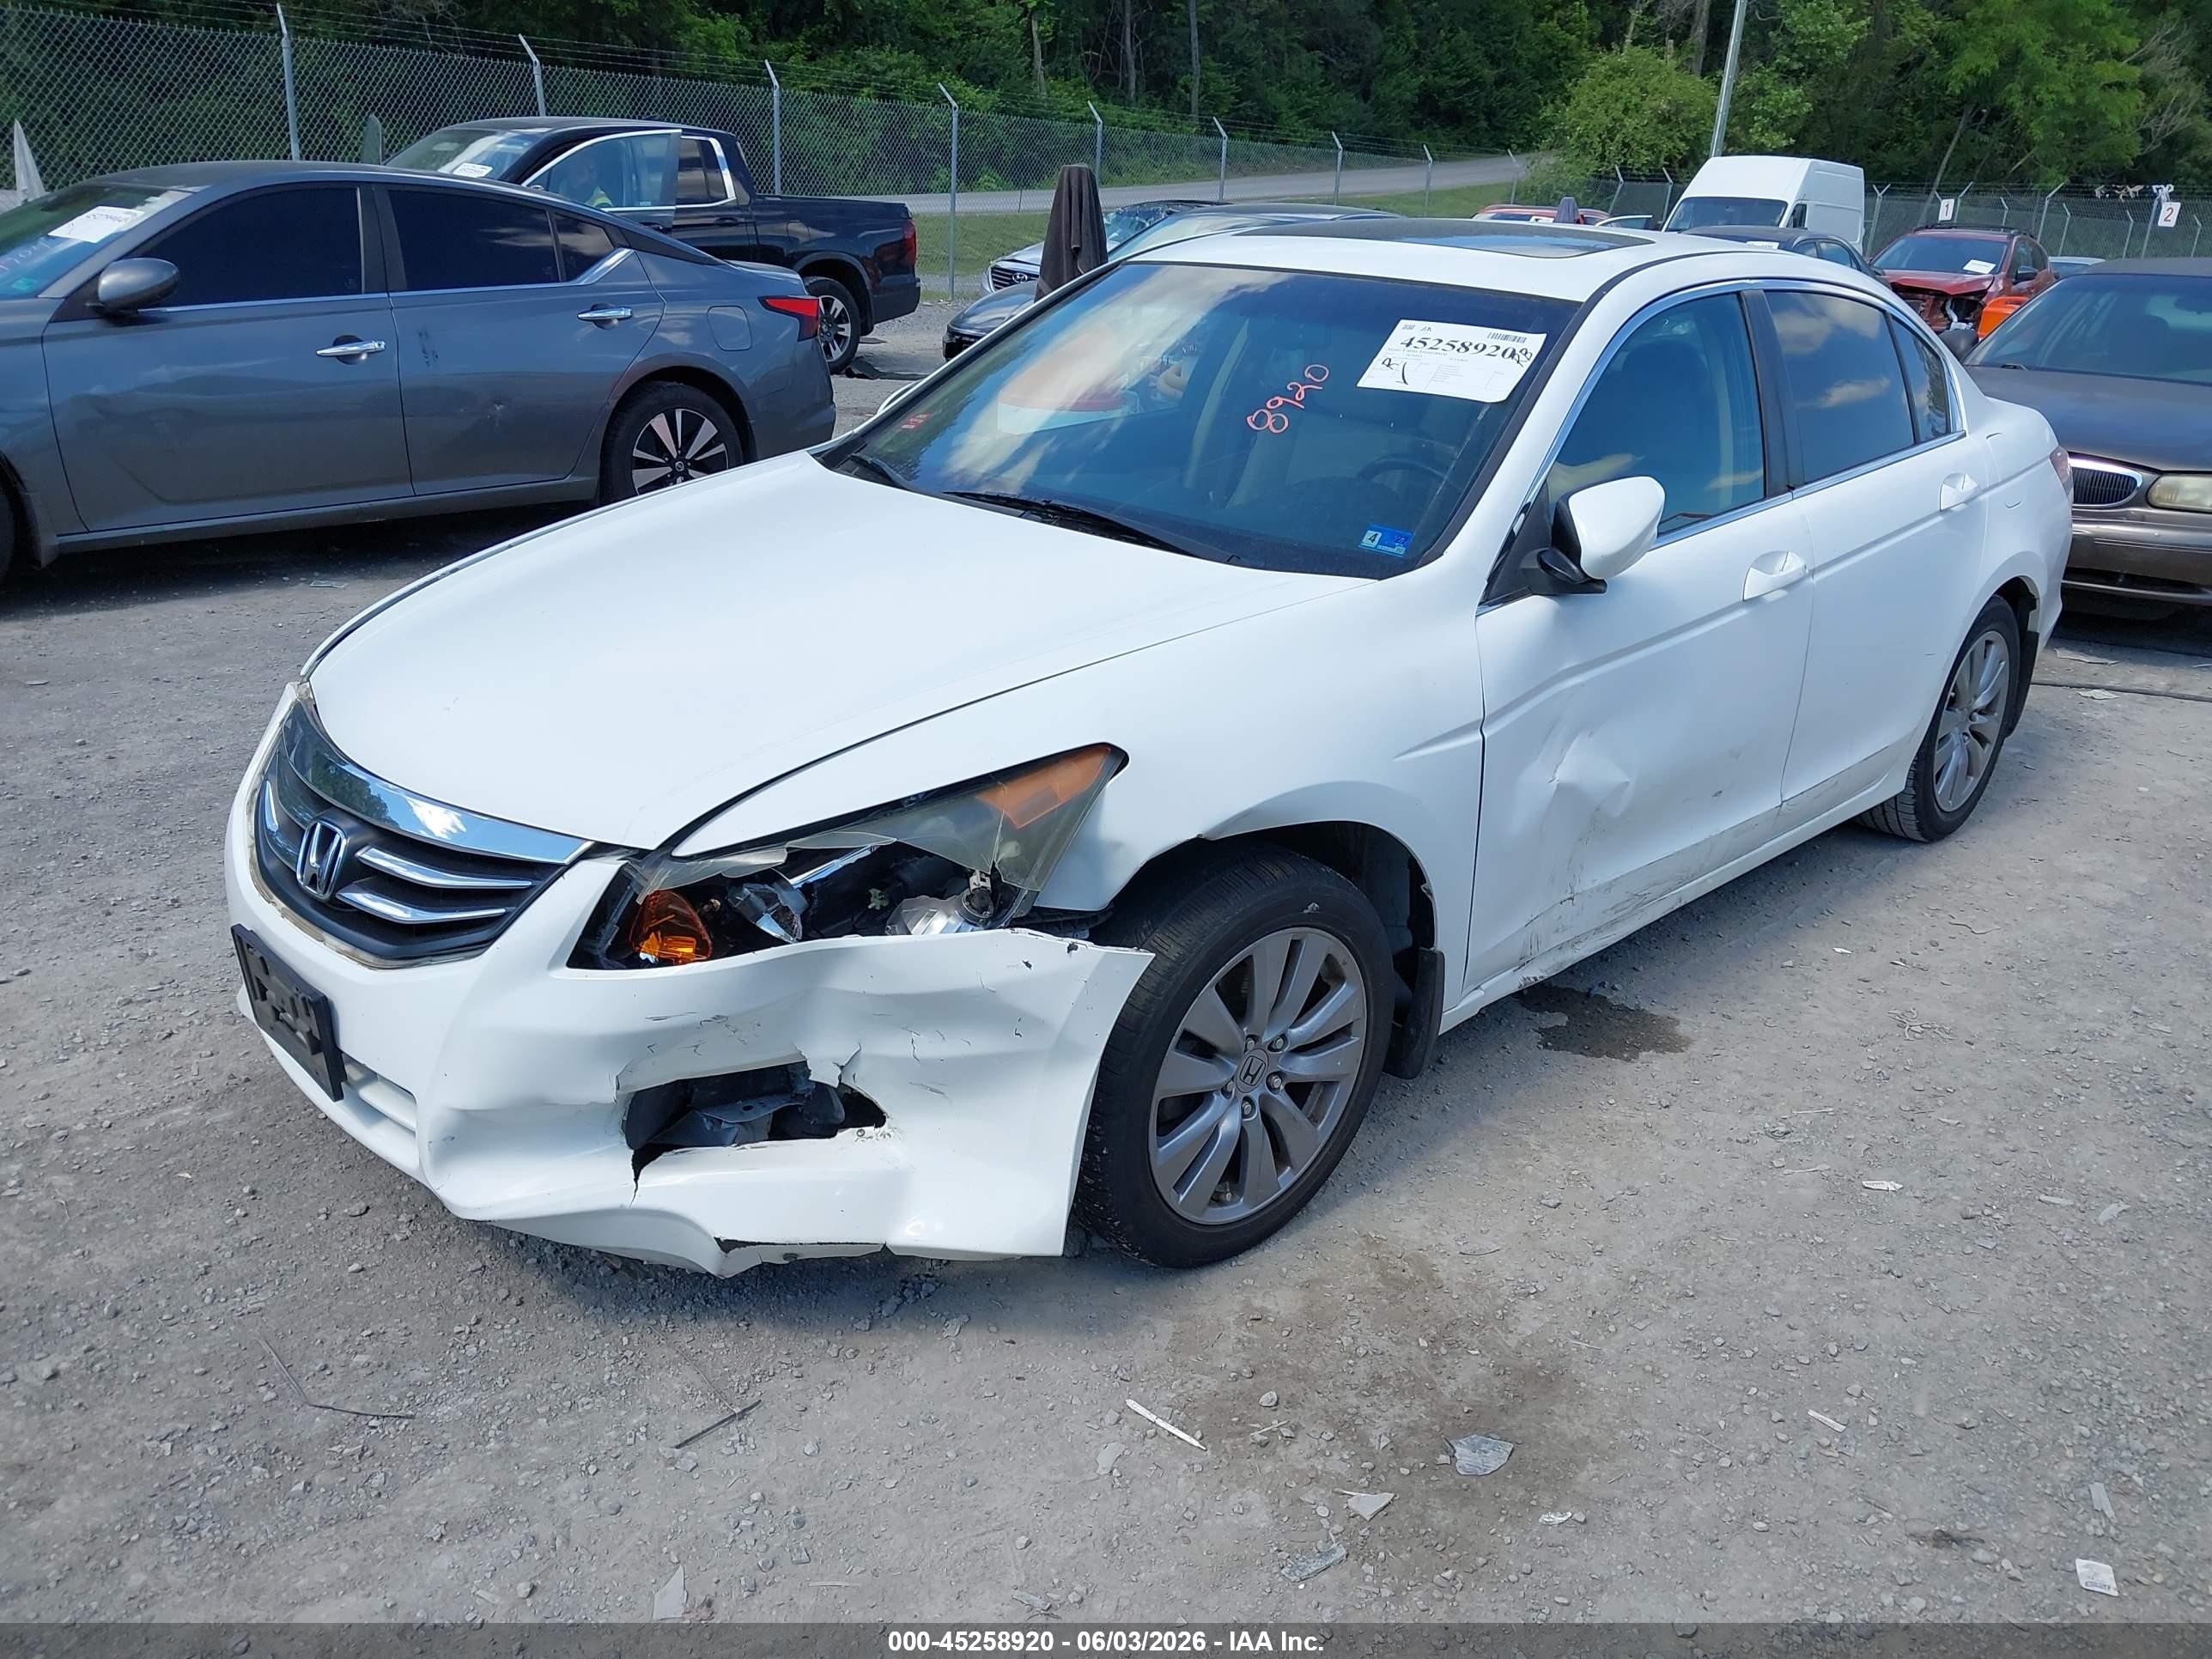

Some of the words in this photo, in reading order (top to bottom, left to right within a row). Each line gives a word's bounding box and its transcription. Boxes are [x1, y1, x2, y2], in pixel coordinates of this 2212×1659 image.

[1944, 203, 1950, 216] 1
[2163, 207, 2174, 222] 2
[1401, 336, 1516, 361] 45258920
[1247, 364, 1329, 434] 8920
[1368, 532, 1379, 544] 4
